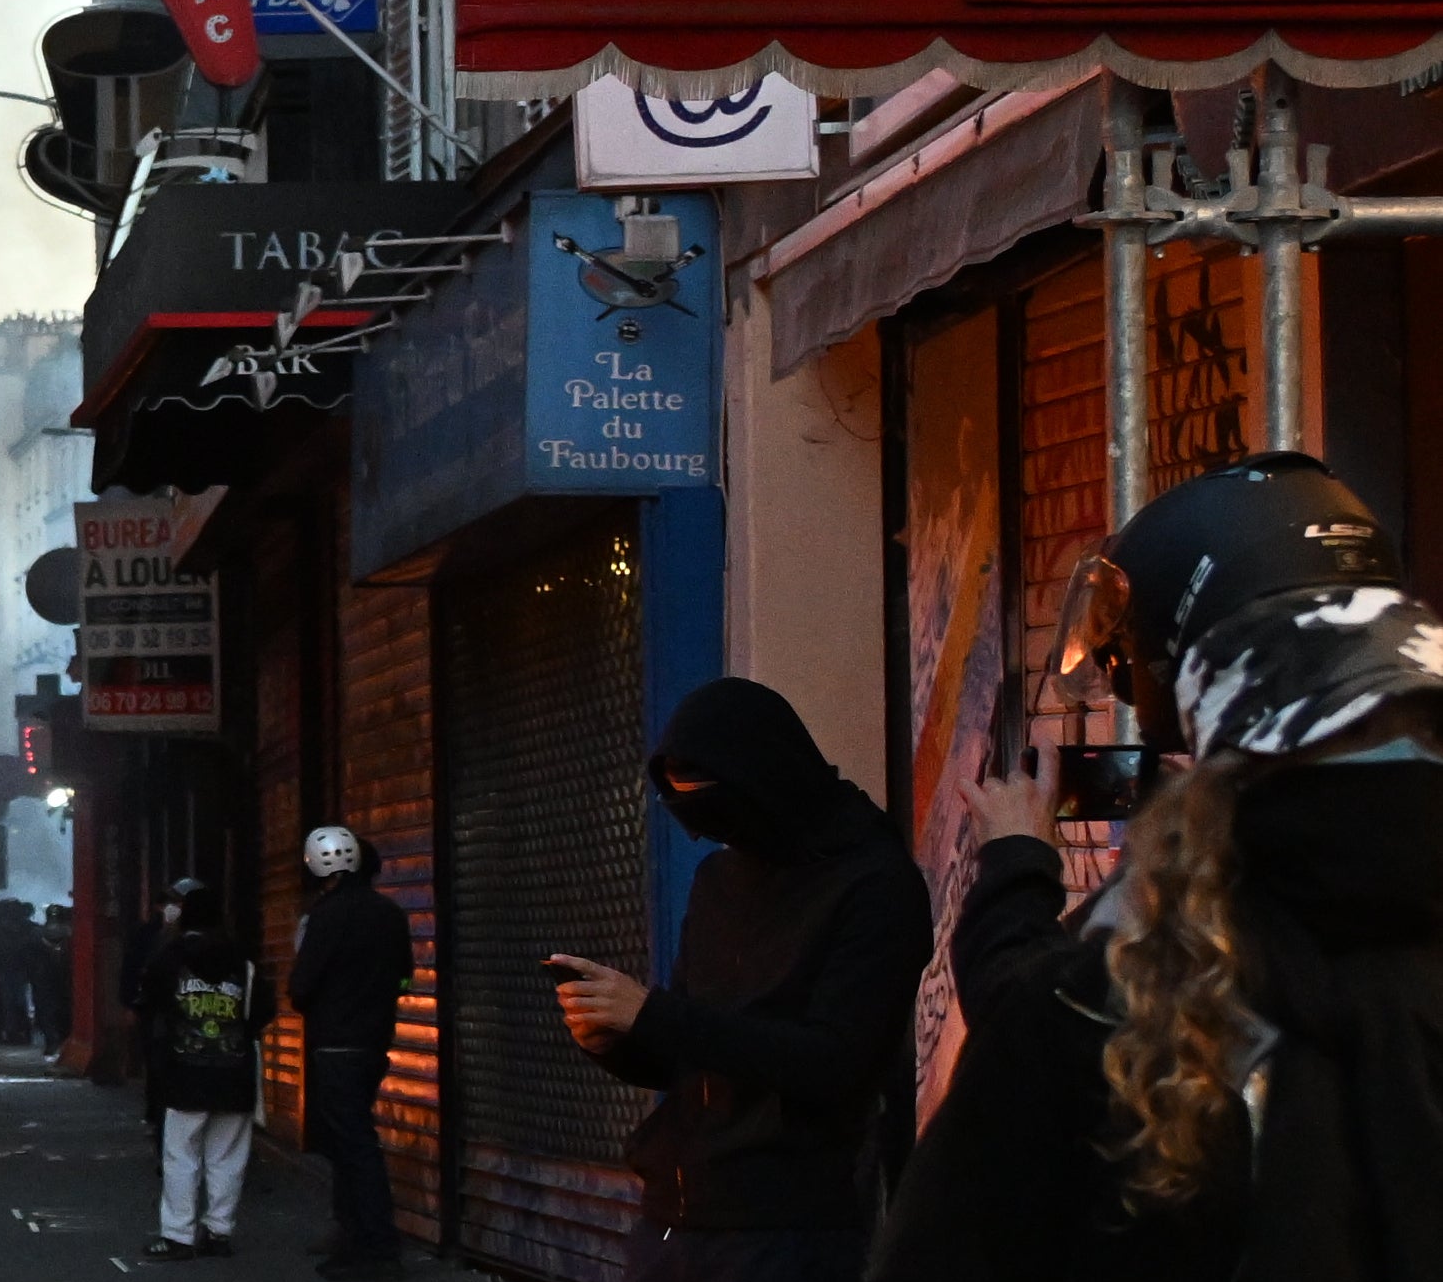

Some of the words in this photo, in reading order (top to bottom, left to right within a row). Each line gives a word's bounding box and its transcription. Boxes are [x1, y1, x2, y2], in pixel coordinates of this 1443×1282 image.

[594, 351, 653, 381] La
[564, 378, 684, 411] Palette
[602, 415, 643, 439] du
[538, 439, 706, 477] Faubourg
[83, 518, 171, 550] BUREA
